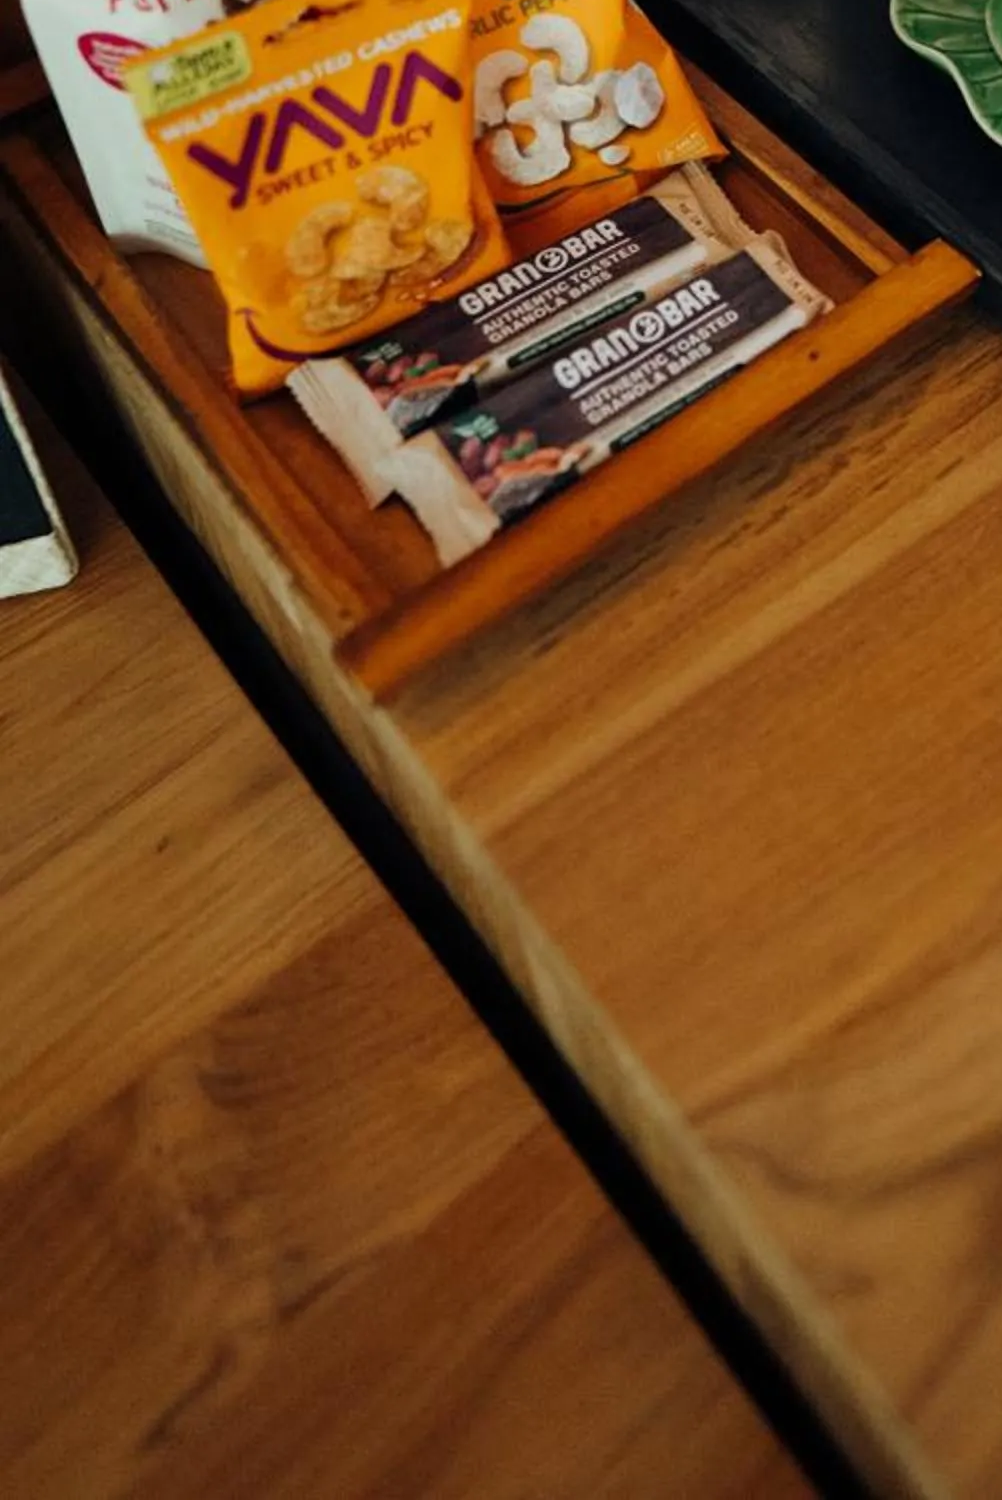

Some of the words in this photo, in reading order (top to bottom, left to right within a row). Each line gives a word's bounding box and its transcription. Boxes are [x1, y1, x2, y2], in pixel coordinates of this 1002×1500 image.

[357, 7, 462, 62] CASHEWS
[187, 50, 463, 210] YAVA
[257, 158, 338, 206] SWEET
[346, 151, 362, 171] &
[368, 121, 434, 163] SPICY
[482, 279, 569, 337] AUTHENTIC
[572, 242, 642, 284] TOASTED
[488, 297, 570, 344] GRANOLA
[569, 271, 614, 301] BARS
[579, 348, 670, 415] AUTHENTIC
[667, 309, 740, 357] TOASTED
[586, 372, 670, 425] GRANOLA
[667, 341, 714, 376] BARS
